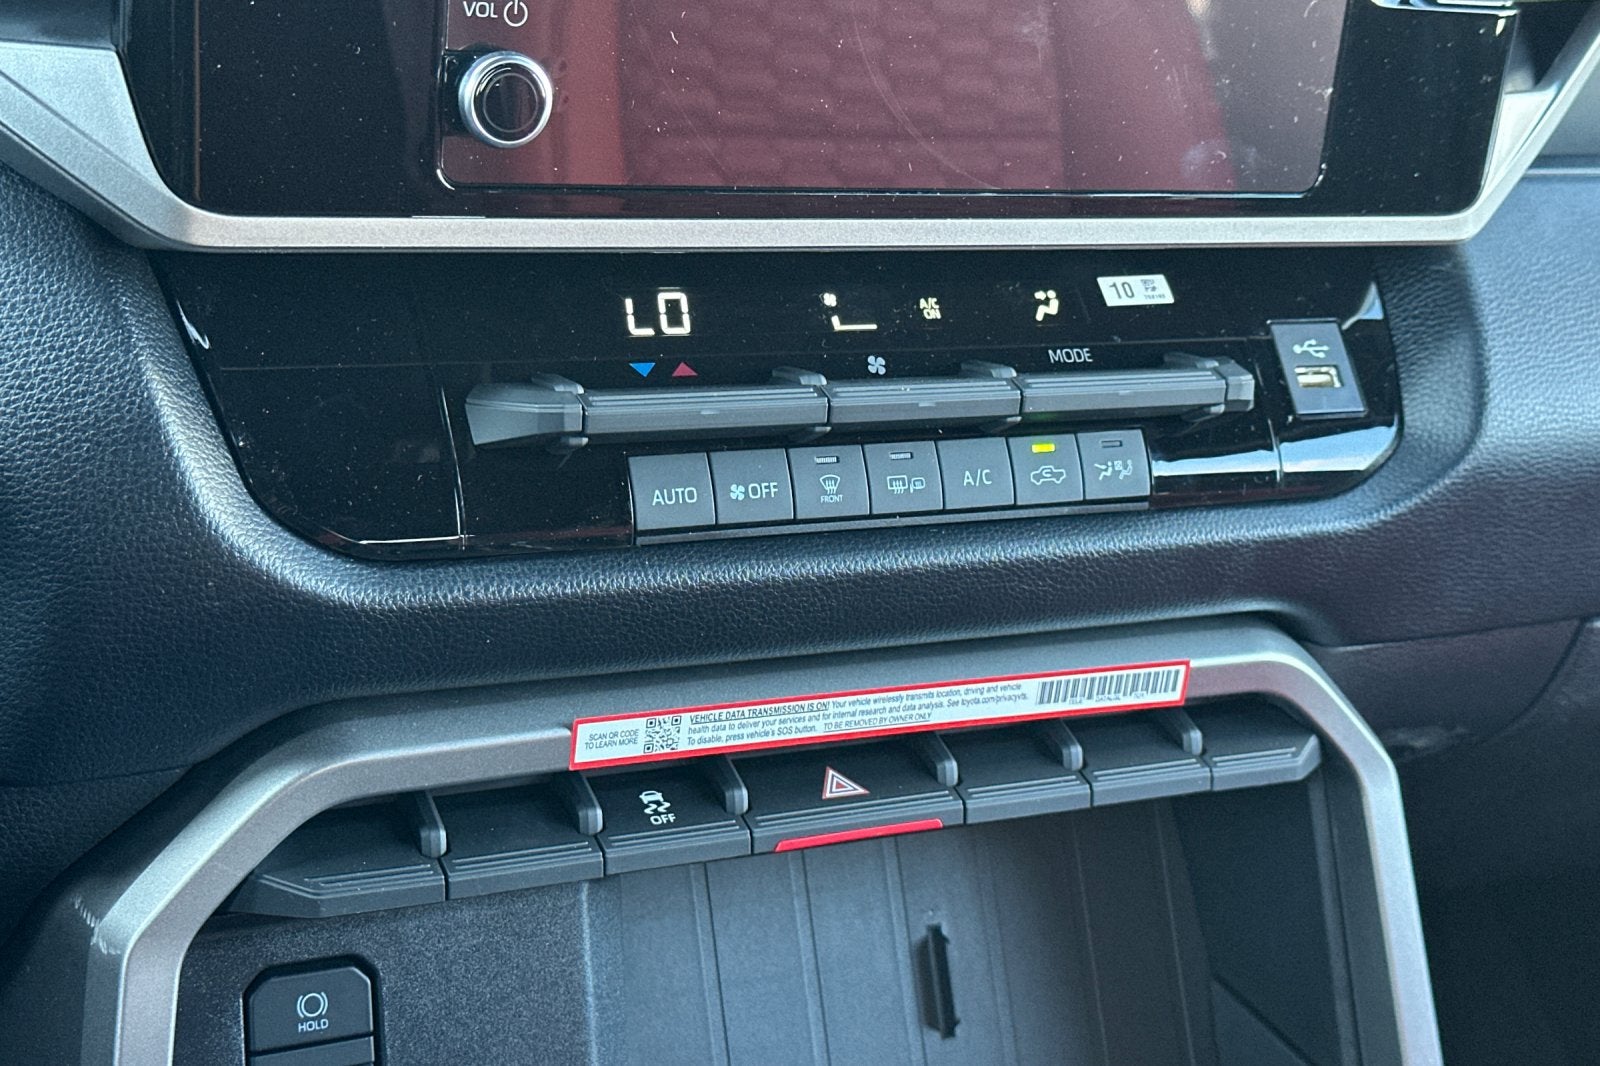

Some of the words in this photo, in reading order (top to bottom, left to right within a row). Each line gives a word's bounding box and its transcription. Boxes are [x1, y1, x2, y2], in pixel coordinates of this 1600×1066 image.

[463, 1, 499, 18] VOL
[1109, 281, 1135, 300] 10
[919, 297, 940, 309] A/C
[923, 309, 942, 320] ON
[1048, 348, 1093, 364] MODE
[963, 469, 993, 487] A/C
[652, 487, 698, 506] AUTO
[749, 482, 779, 500] OFF
[820, 494, 844, 504] FRONT
[690, 712, 723, 723] VEHICLE
[725, 709, 745, 719] DATA
[748, 704, 805, 717] TRANSMISSION
[807, 703, 814, 711] IS
[816, 701, 830, 711] ON!
[832, 700, 847, 709] Your
[848, 697, 871, 707] vehicle
[873, 694, 904, 705] wirelessly
[905, 690, 935, 701] transmits
[963, 686, 985, 696] driving
[986, 685, 998, 693] and
[1000, 682, 1021, 691] vehicle
[688, 723, 710, 735] health
[711, 721, 727, 732] data
[728, 721, 735, 731] to
[737, 717, 760, 729] deliver
[761, 718, 777, 729] your
[778, 715, 806, 726] services
[807, 713, 820, 722] and
[822, 711, 831, 721] for
[832, 708, 857, 719] internal
[858, 706, 887, 716] research
[888, 704, 900, 713] and
[902, 702, 917, 712] data
[947, 699, 959, 708] See
[824, 722, 833, 731] TO
[834, 721, 843, 729] BE
[845, 718, 878, 728] REMOVED
[879, 716, 888, 724] BY
[889, 714, 913, 723] OWNER
[915, 711, 932, 720] ONLY
[585, 742, 593, 750] TO
[595, 740, 617, 749] LEARN
[618, 737, 638, 746] MORE
[589, 732, 607, 742] SCAN
[620, 729, 639, 739] CODE
[688, 737, 696, 746] To
[725, 733, 745, 743] press
[746, 728, 775, 739] vehicle's
[777, 726, 793, 736] SOS
[650, 813, 676, 825] OFF
[298, 1018, 329, 1032] HOLD
